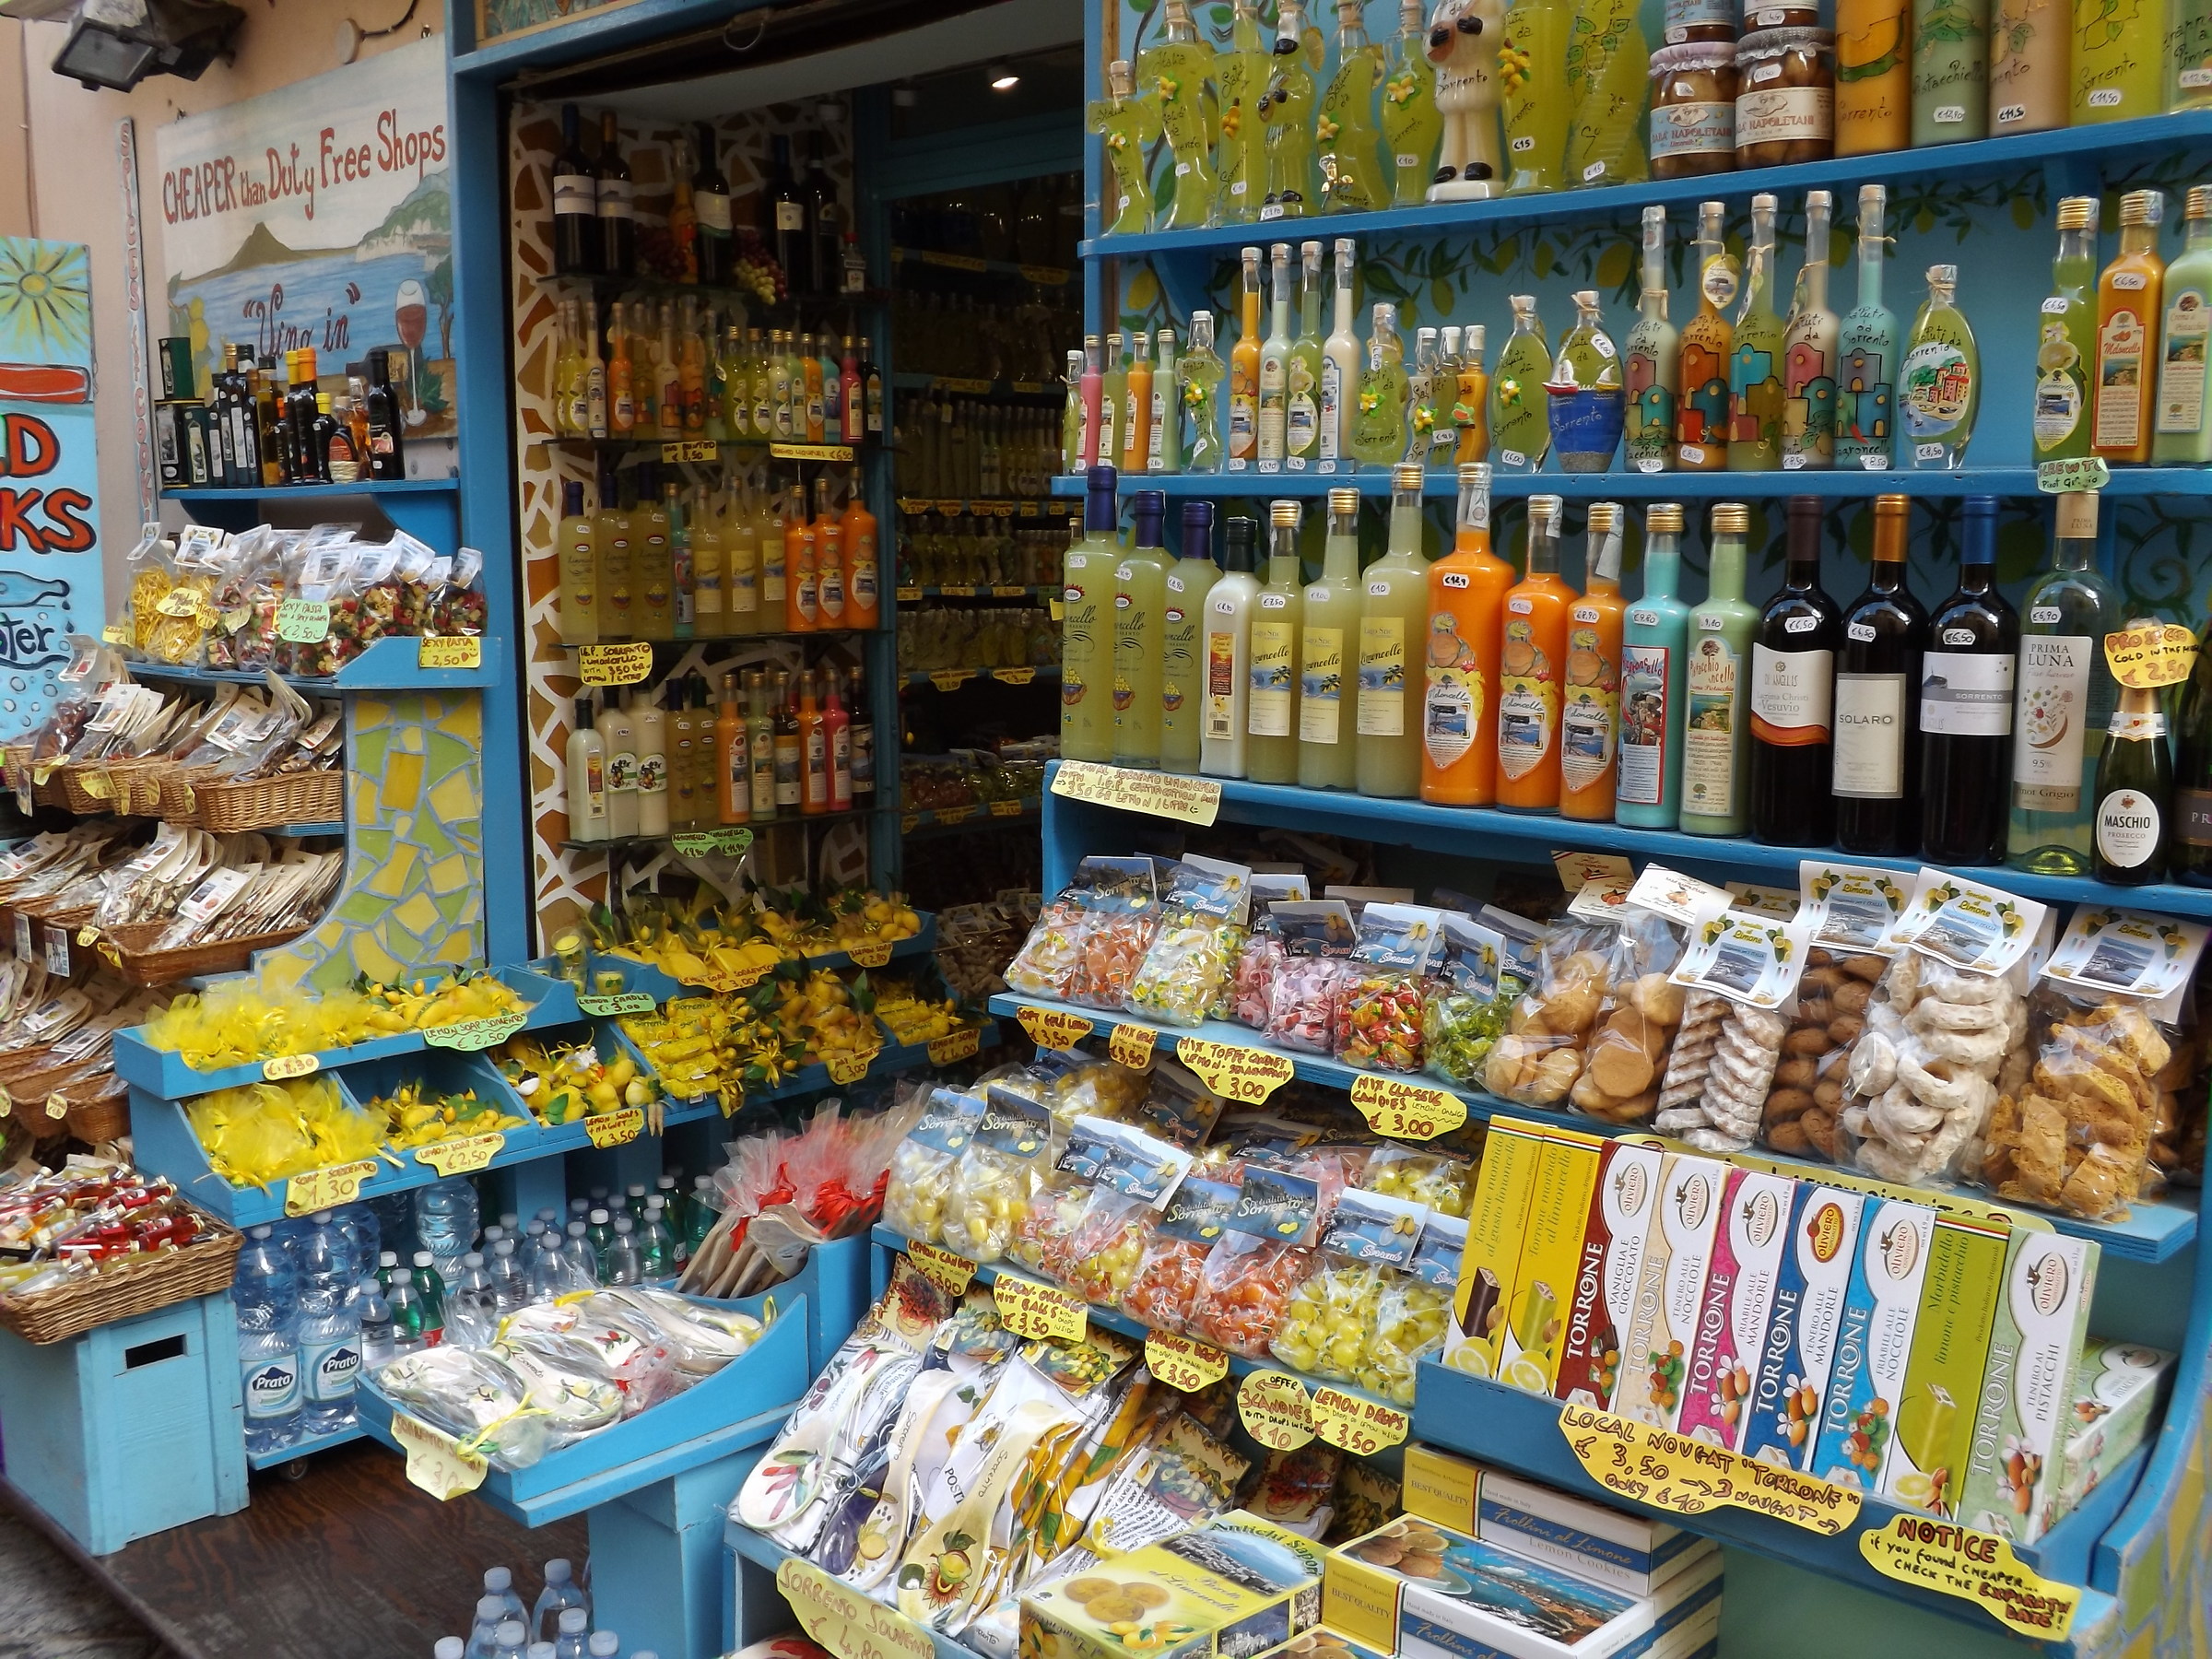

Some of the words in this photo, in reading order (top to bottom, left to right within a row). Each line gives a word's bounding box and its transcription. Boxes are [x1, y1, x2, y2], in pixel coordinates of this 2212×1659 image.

[1437, 74, 1488, 95] Sorrento
[2076, 54, 2137, 108] Sorrento
[1513, 138, 1532, 149] €15
[163, 156, 238, 225] CHEAPER
[241, 170, 266, 208] than
[266, 142, 314, 220] Duty
[320, 127, 371, 189] Free
[376, 109, 445, 183] Shops
[2044, 300, 2065, 311] €6,50
[1843, 327, 1889, 347] Sorrento
[1492, 411, 1532, 444] Sorrento
[1553, 407, 1602, 433] Sorrento
[1919, 446, 1942, 457] €8,50
[2042, 477, 2061, 488] Pinot
[1371, 583, 1386, 593] €10
[2032, 612, 2058, 622] €6,90
[1360, 643, 1403, 666] Limoncello
[2028, 654, 2075, 667] LUNA
[2031, 643, 2070, 654] PRIMA
[2114, 653, 2144, 664] COLD
[2145, 659, 2187, 683] 2,50
[1761, 701, 1800, 712] Vesuvio
[1839, 714, 1892, 724] SOLARO
[1059, 770, 1085, 782] WITH
[1129, 782, 1198, 802] CERTIFICATION
[1062, 760, 1110, 777] ORIGINAL
[1113, 769, 1162, 785] SORRENTO
[1164, 774, 1220, 793] LIMONCELLO
[1066, 782, 1093, 798] 350
[1116, 792, 1152, 807] LEMON
[2040, 788, 2075, 800] Grigio
[2105, 815, 2150, 830] MASCHIO
[1841, 883, 1873, 897] Limone
[1958, 900, 1991, 918] Limone
[1733, 930, 1763, 945] Limone
[2117, 923, 2153, 941] Limone
[613, 994, 649, 1004] CANDLE
[1018, 1008, 1039, 1023] SOFT
[426, 1026, 458, 1039] LEMON
[460, 1020, 480, 1031] SOAP
[474, 1031, 506, 1046] 2,50
[1042, 1030, 1070, 1047] 3,50
[1117, 1023, 1136, 1036] MIX
[1180, 1037, 1204, 1053] MIX
[1229, 1077, 1265, 1100] 3,00
[1351, 1090, 1406, 1112] CANDIES
[1412, 1103, 1435, 1112] LEMON
[1358, 1077, 1384, 1092] MIX
[1389, 1082, 1444, 1107] CLASSIC
[585, 1116, 610, 1125] LEMON
[615, 1111, 640, 1120] SOAPS
[982, 1112, 1037, 1132] Sorrento
[1392, 1113, 1435, 1136] 3,00
[1624, 1166, 1639, 1213] OLIVIERO
[1686, 1179, 1701, 1226] OLIVIERO
[1754, 1194, 1771, 1243] OLIVIERO
[1818, 1207, 1835, 1260] OLIVIERO
[1891, 1224, 1908, 1277] OLIVIERO
[1610, 1249, 1626, 1306] VANIGLIA
[1618, 1235, 1641, 1315] CIOCCOLATO
[1926, 1231, 1955, 1313] Morbidello
[2039, 1256, 2057, 1311] OLIVIERO
[1566, 1241, 1605, 1360] TORRONE
[1672, 1280, 1687, 1318] TENERO
[1681, 1256, 1690, 1279] ALLE
[1681, 1253, 1702, 1325] NOCCIOLE
[995, 1291, 1016, 1306] MIX
[1021, 1297, 1057, 1318] BALLS
[1039, 1289, 1087, 1313] ORANGE
[1738, 1296, 1751, 1339] FRIABILE
[1747, 1271, 1758, 1295] ALLE
[1747, 1269, 1771, 1347] MANDORLE
[1017, 1312, 1050, 1335] 3,50
[1628, 1255, 1665, 1376] TORRONE
[1805, 1316, 1820, 1357] TENERO
[1814, 1289, 1825, 1314] ALLE
[1814, 1286, 1839, 1366] MANDORLE
[1691, 1272, 1732, 1395] TORRONE
[1876, 1332, 1891, 1376] FRIABILE
[1886, 1305, 1897, 1330] ALLE
[1885, 1305, 1911, 1382] NOCCIOLE
[1933, 1318, 1952, 1366] limone
[326, 1355, 358, 1370] Prato
[1147, 1330, 1191, 1355] ORANGE
[1194, 1343, 1228, 1369] DROPS
[1754, 1288, 1798, 1414] TORRONE
[255, 1374, 291, 1388] Prato
[1167, 1362, 1201, 1389] 3,50
[1269, 1375, 1299, 1391] OFFER
[1823, 1304, 1868, 1436] TORRONE
[2036, 1342, 2061, 1423] PISTACCHI
[2026, 1362, 2041, 1408] TENERO
[1245, 1409, 1265, 1420] WITH
[1268, 1417, 1290, 1428] DROPS
[1315, 1387, 1361, 1416] LEMON
[1364, 1404, 1406, 1431] DROPS
[1971, 1341, 2015, 1478] TORRONE
[1268, 1427, 1292, 1449] 10
[1336, 1423, 1377, 1453] 3,50
[1564, 1405, 1636, 1442] LOCAL
[1648, 1432, 1735, 1474] NOUGAT
[978, 1448, 1009, 1499] Sorrento
[1605, 1473, 1650, 1500] ONLY
[1612, 1442, 1670, 1480] 3,50
[1735, 1489, 1818, 1522] NOUGAT
[1433, 1486, 1470, 1508] QUALITY
[1209, 1521, 1289, 1546] Antichi
[1494, 1507, 1552, 1538] Frollini
[1573, 1534, 1632, 1566] Limone
[1897, 1517, 2000, 1564] NOTICE
[1528, 1536, 1571, 1559] Lemon
[1576, 1551, 1631, 1580] Cookies
[1887, 1540, 1911, 1556] you
[1916, 1547, 1957, 1570] found
[1894, 1558, 1938, 1581] CHECK
[1944, 1574, 1973, 1591] THE
[1354, 1596, 1392, 1619] QUALITY
[1415, 1621, 1475, 1655] Frollini
